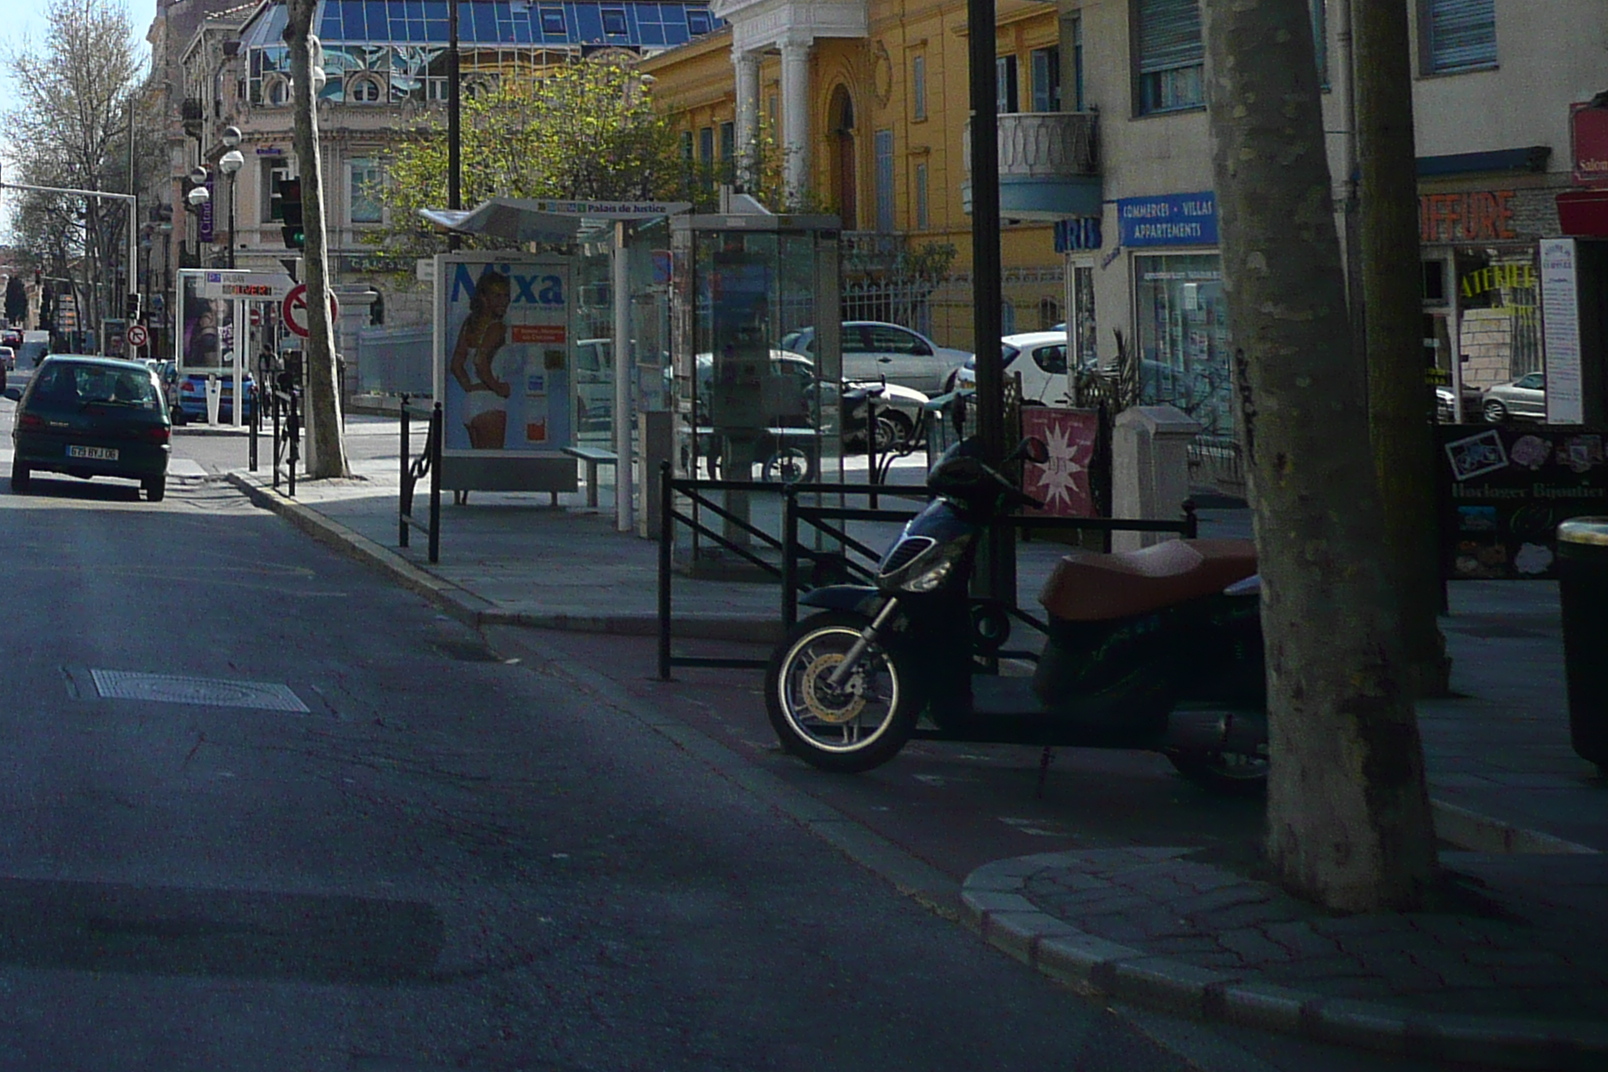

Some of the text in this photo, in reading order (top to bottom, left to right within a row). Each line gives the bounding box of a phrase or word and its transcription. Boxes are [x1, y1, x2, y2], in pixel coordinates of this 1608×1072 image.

[588, 204, 616, 213] Palais
[619, 204, 631, 213] de
[634, 204, 666, 213] Justice
[1123, 201, 1212, 218] COMMERCES VILLAS
[1134, 223, 1201, 238] APPARTEMENTS
